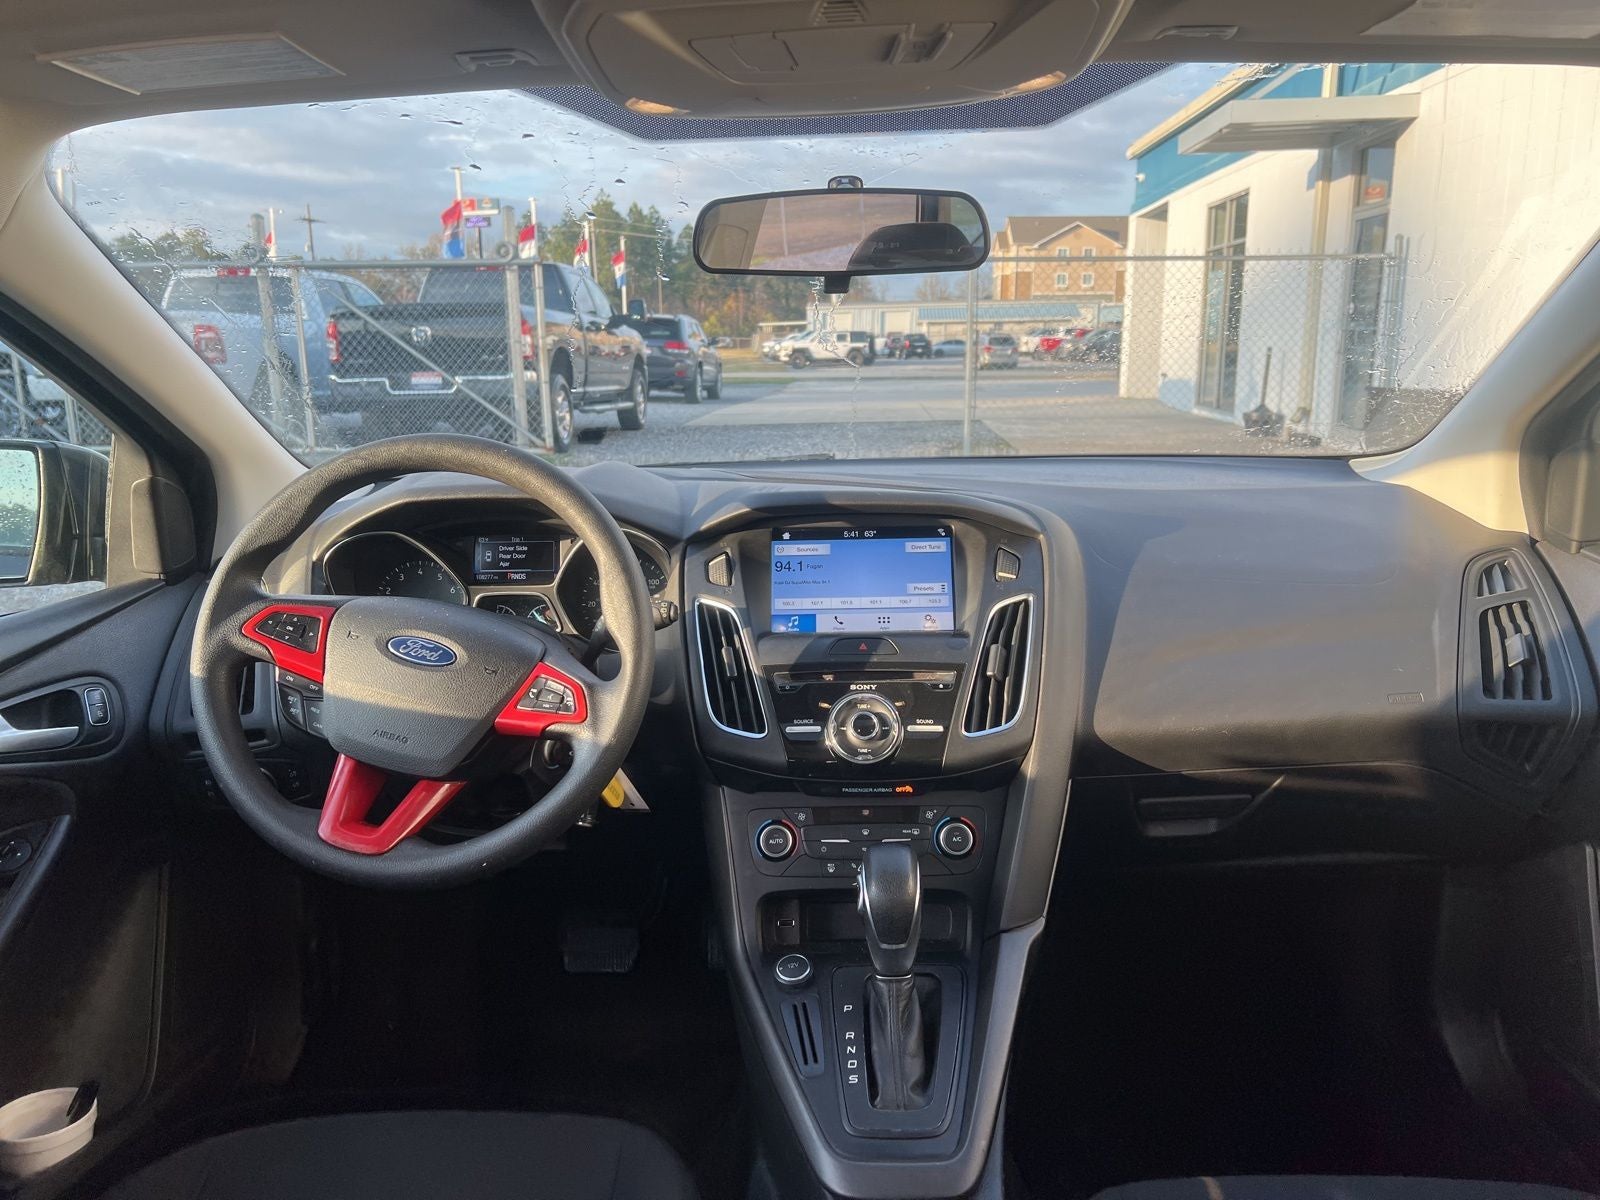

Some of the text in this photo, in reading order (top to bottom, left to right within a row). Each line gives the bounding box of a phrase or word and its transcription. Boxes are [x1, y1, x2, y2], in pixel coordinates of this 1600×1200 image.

[843, 530, 877, 538] 5:41 63°
[417, 567, 423, 575] 4
[774, 560, 804, 573] 94.1
[399, 573, 405, 581] 3
[437, 573, 443, 581] 5
[385, 587, 392, 595] 2
[449, 586, 456, 594] 6
[587, 600, 596, 608] 20
[399, 639, 444, 661] Ford
[372, 729, 409, 744] AIRBAG
[843, 1004, 853, 1013] P
[845, 1031, 855, 1040] R
[846, 1045, 856, 1054] N
[847, 1059, 858, 1068] D
[848, 1074, 859, 1084] S
